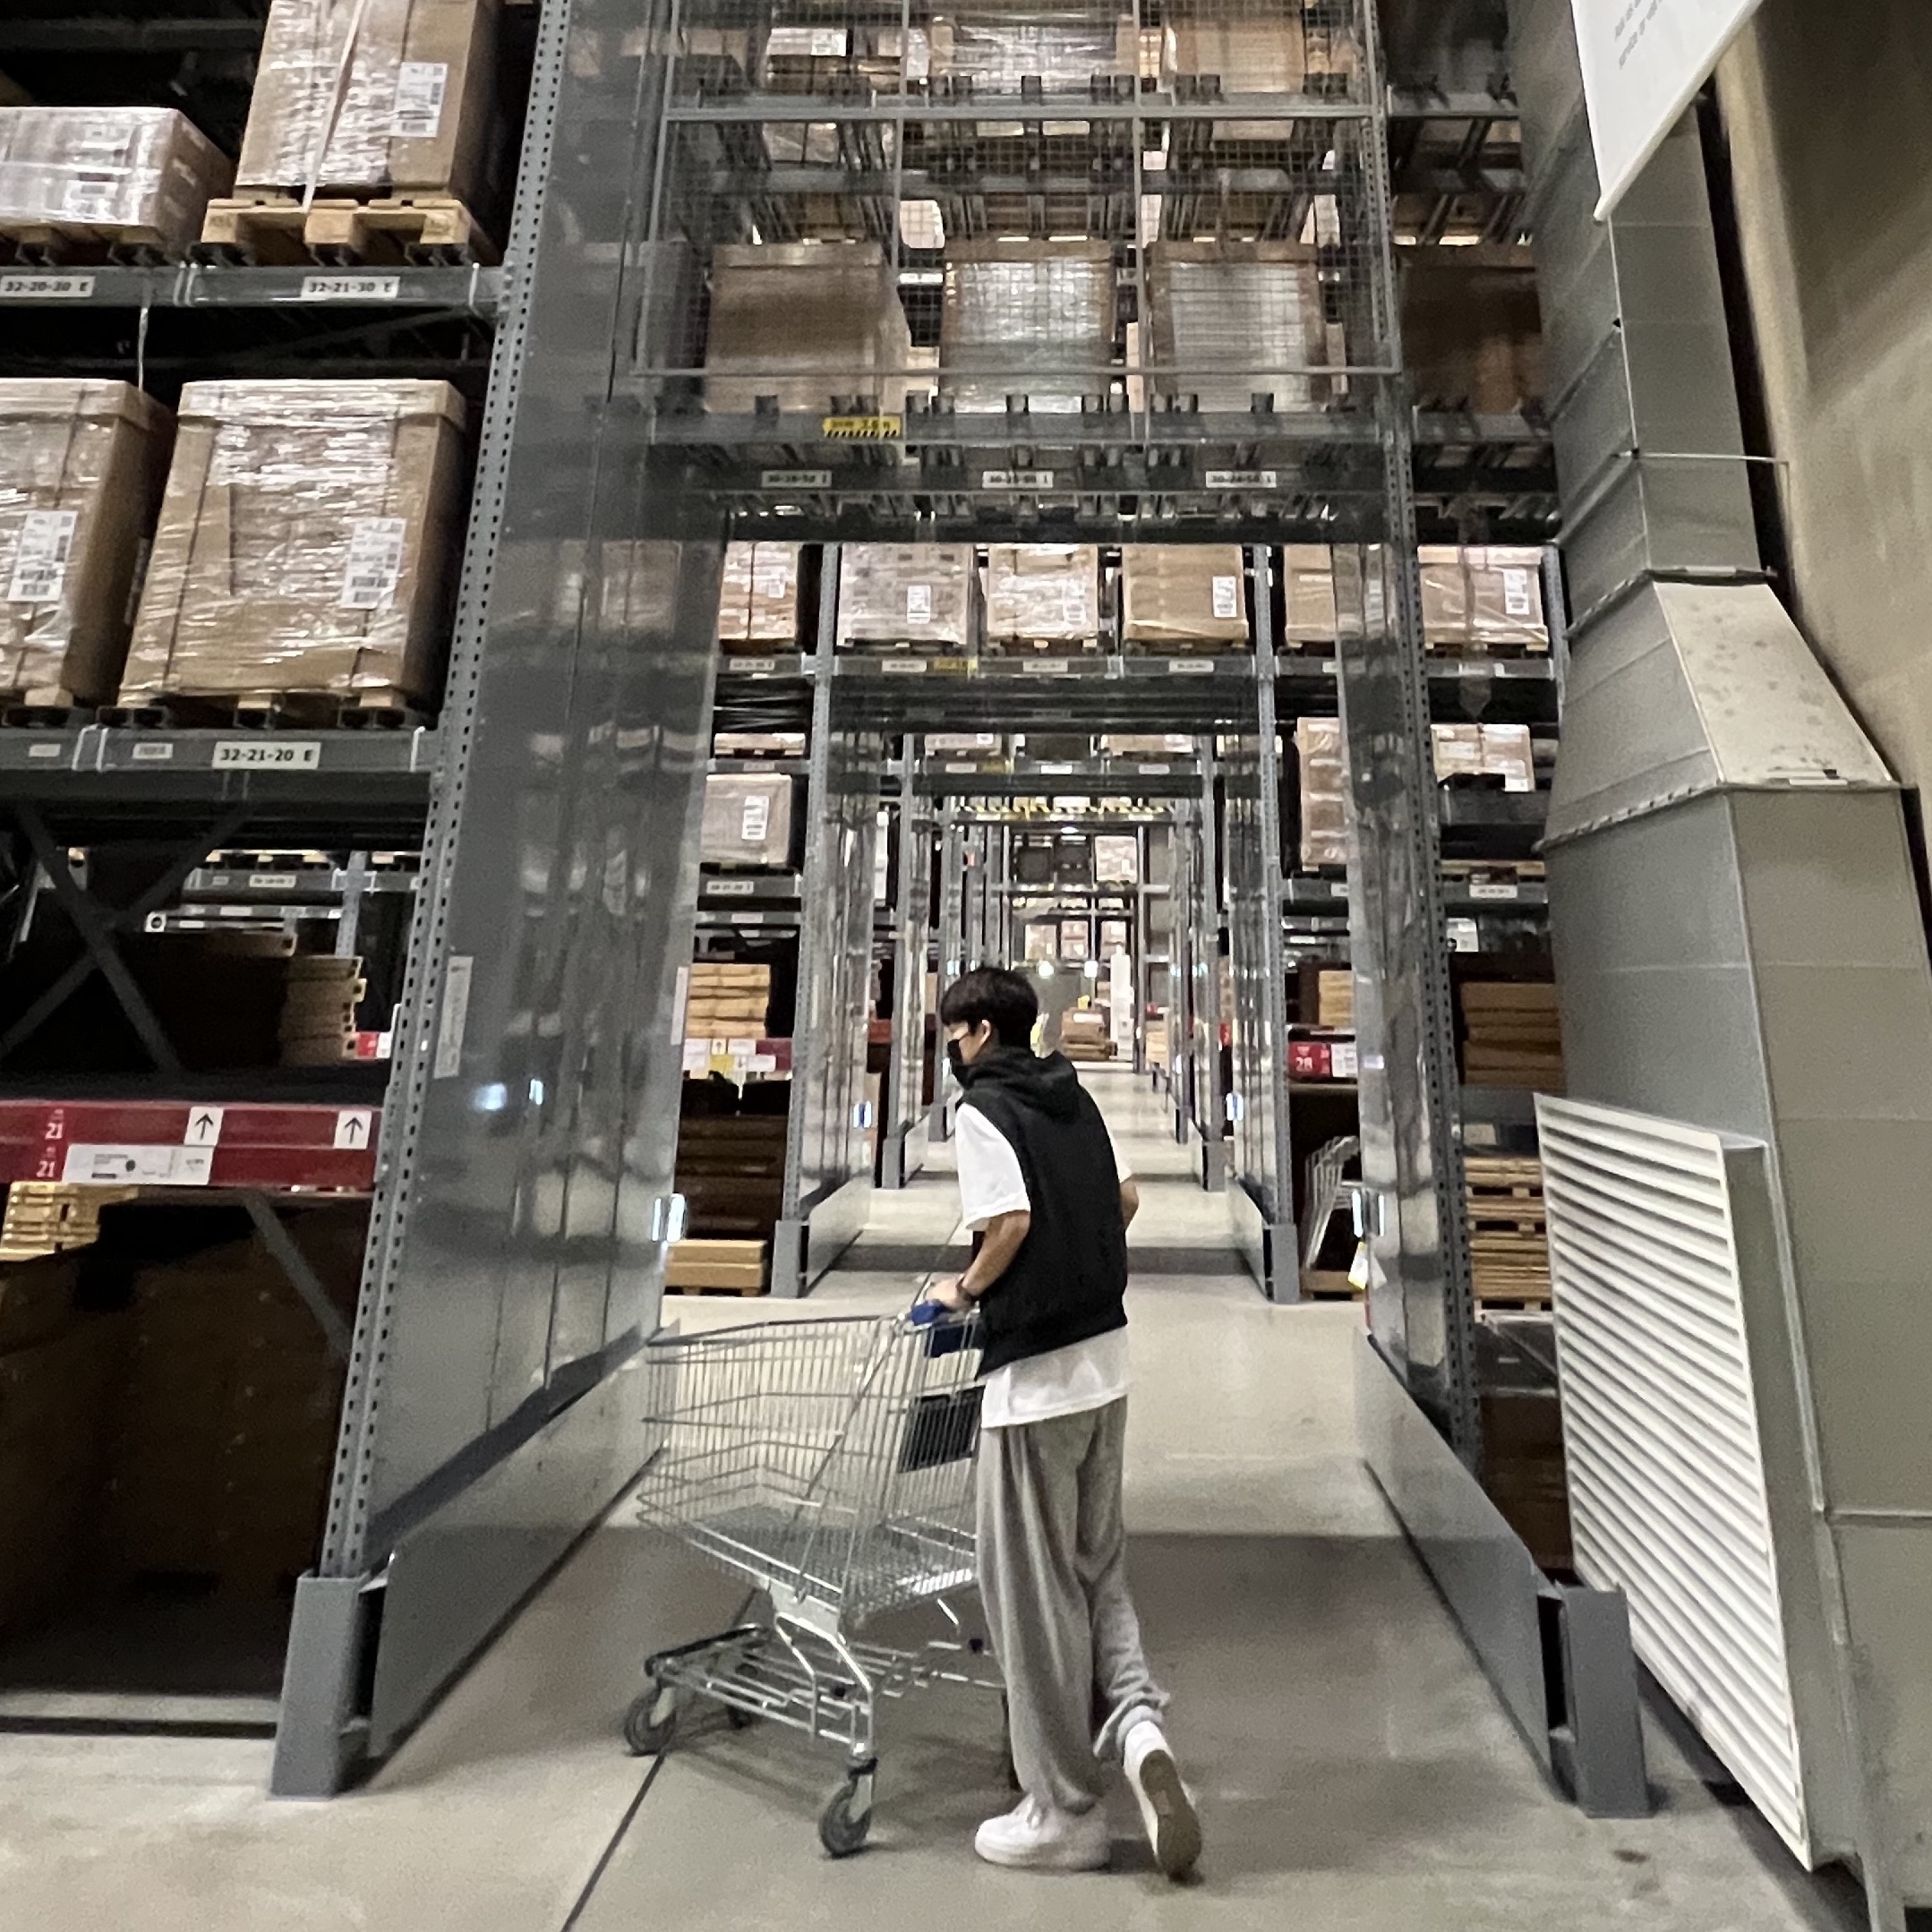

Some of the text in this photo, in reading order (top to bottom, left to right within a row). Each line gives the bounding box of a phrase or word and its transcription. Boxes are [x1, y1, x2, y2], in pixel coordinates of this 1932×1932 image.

[220, 748, 314, 762] 32-21-20 E
[45, 1123, 64, 1140] 21
[36, 1160, 56, 1178] 21
